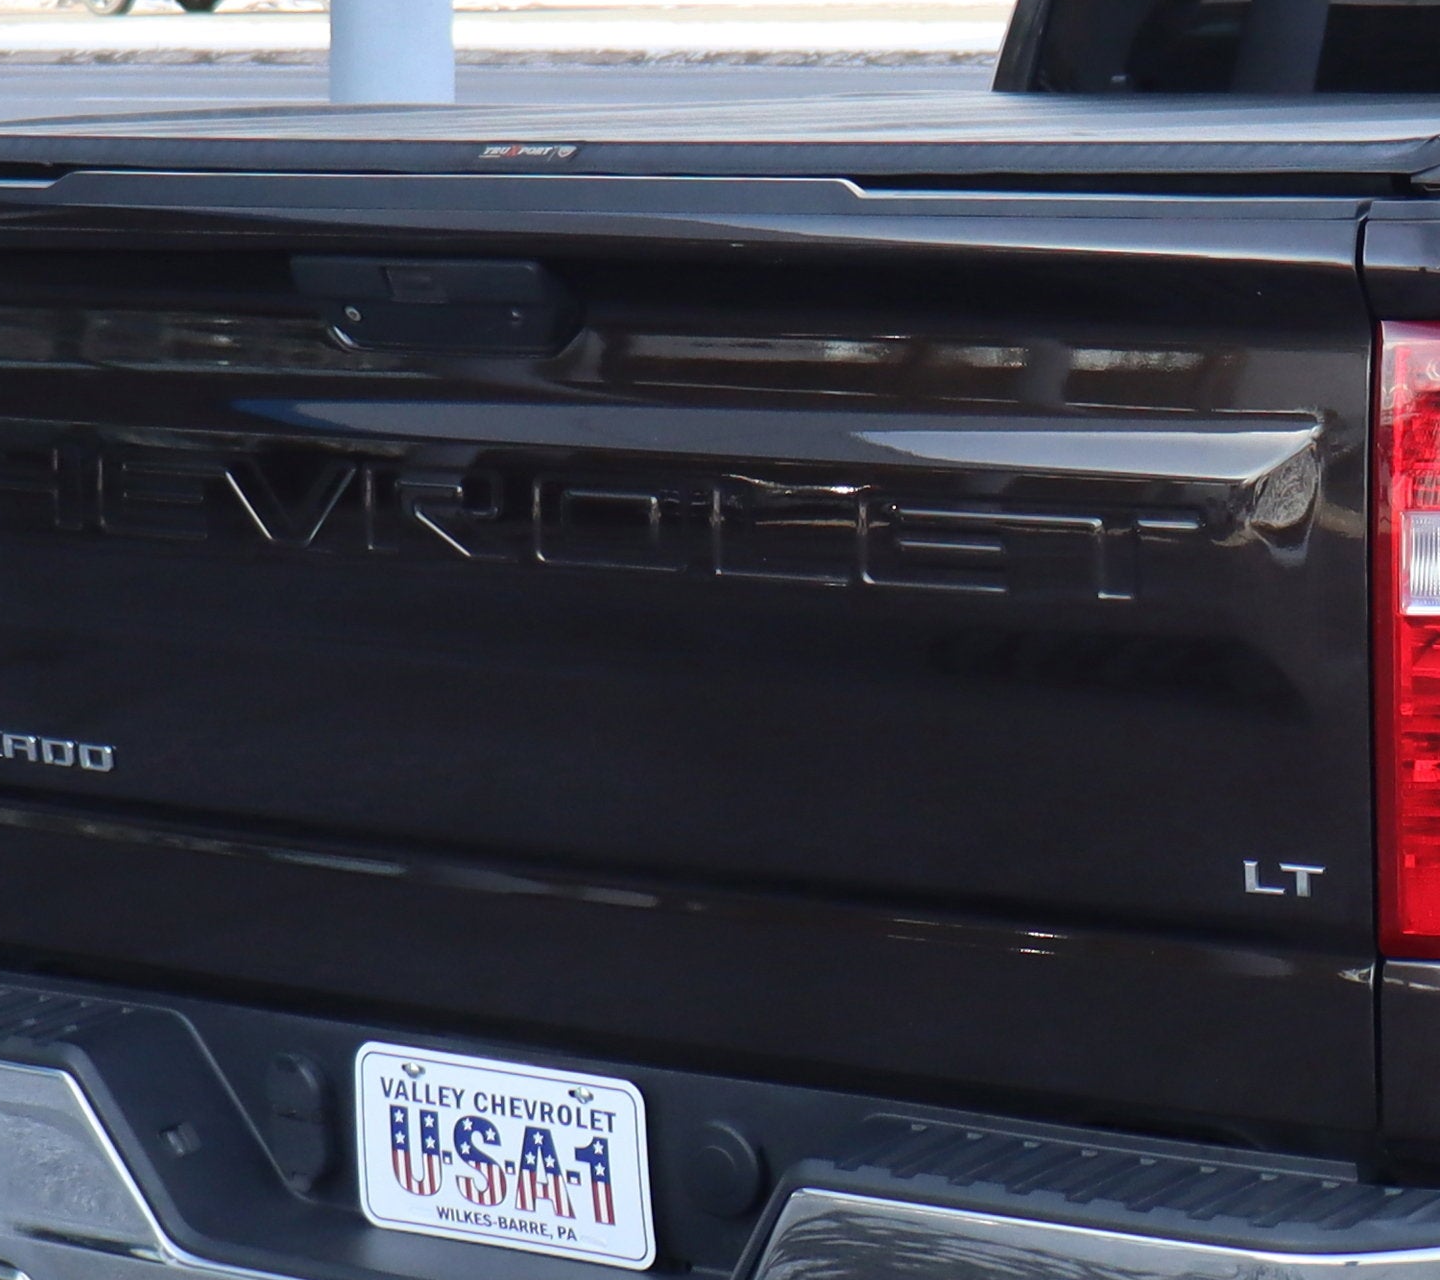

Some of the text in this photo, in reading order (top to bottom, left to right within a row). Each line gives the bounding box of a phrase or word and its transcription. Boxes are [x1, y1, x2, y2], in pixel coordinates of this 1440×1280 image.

[1242, 859, 1326, 898] LT
[380, 1076, 617, 1134] VALLEY CHEVROLET
[436, 1205, 578, 1241] WILKES-BARRE, PA
